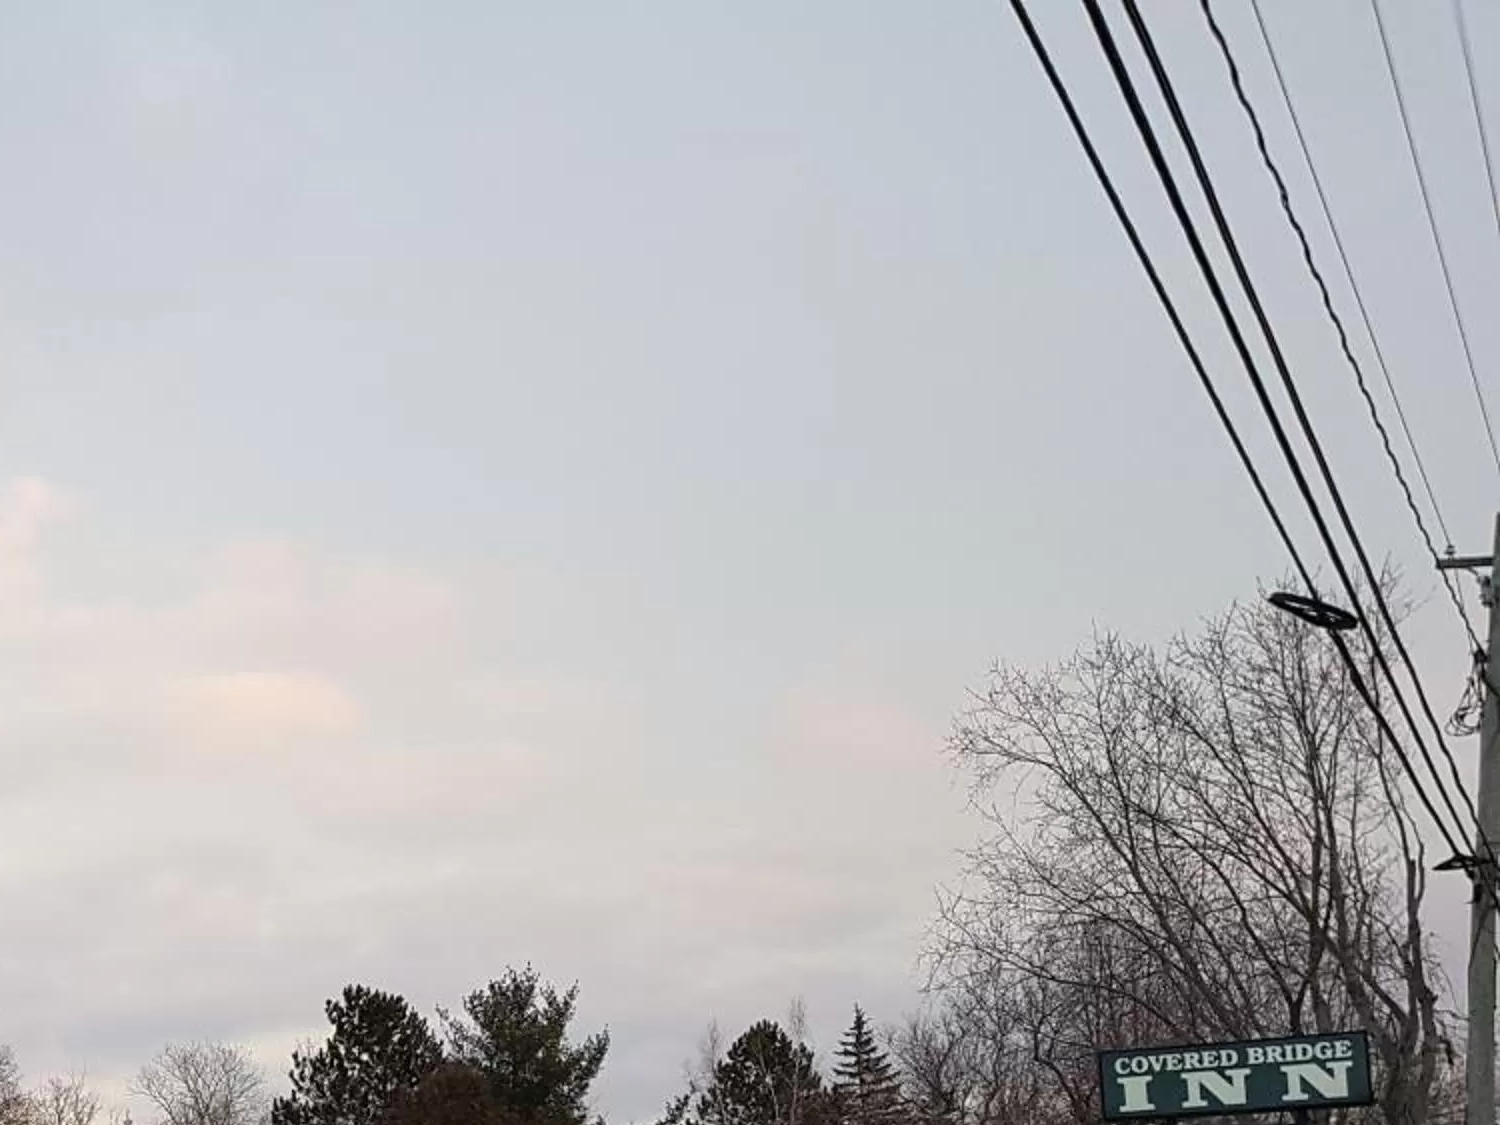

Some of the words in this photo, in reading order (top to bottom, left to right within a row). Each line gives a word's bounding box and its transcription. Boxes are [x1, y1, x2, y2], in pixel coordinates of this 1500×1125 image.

[1114, 1050, 1238, 1076] COVERED
[1247, 1039, 1353, 1065] BRIDGE
[1116, 1060, 1353, 1113] INN
